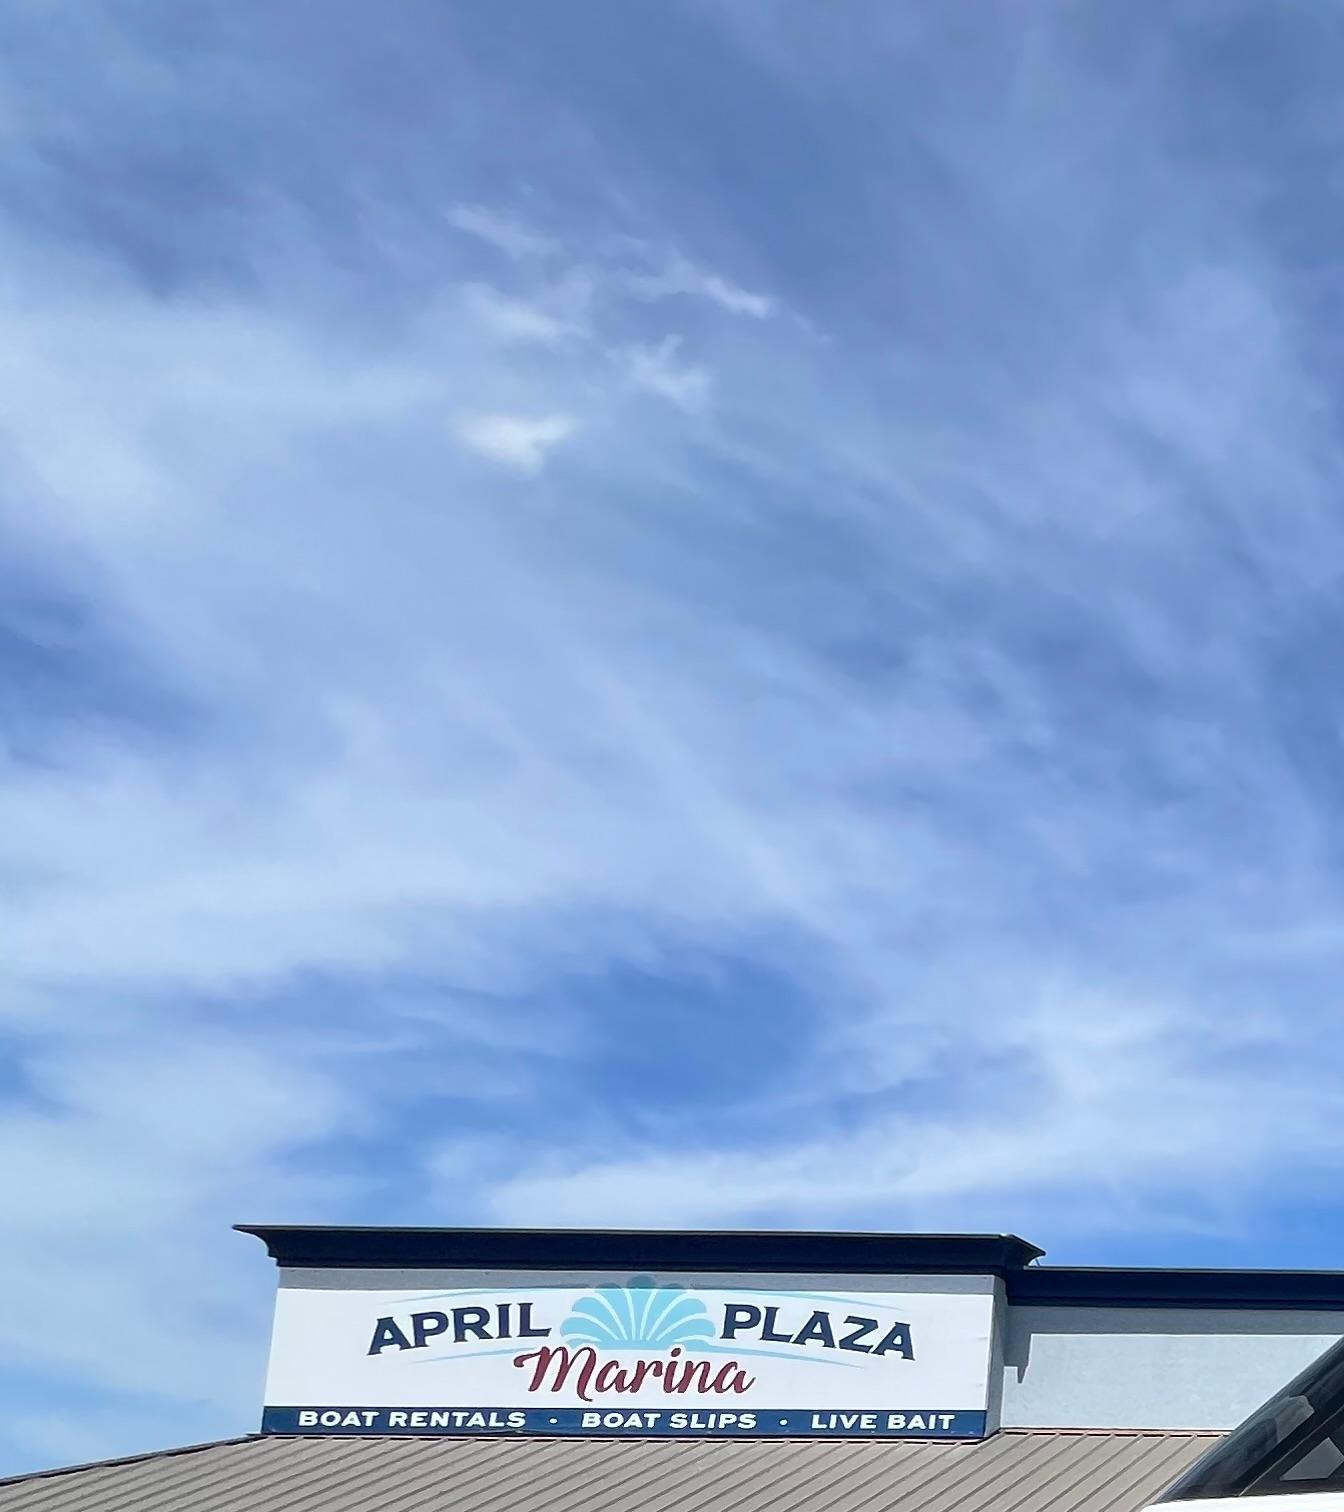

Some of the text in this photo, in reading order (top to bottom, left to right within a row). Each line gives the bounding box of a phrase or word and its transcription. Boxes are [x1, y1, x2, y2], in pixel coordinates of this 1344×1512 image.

[366, 1302, 916, 1361] APRIL PLAZA
[513, 1346, 756, 1402] Marina
[299, 1411, 526, 1428] BOAT RENTALS
[581, 1412, 756, 1430] BOAT SLIPS
[811, 1413, 955, 1431] LIVE BAIT
